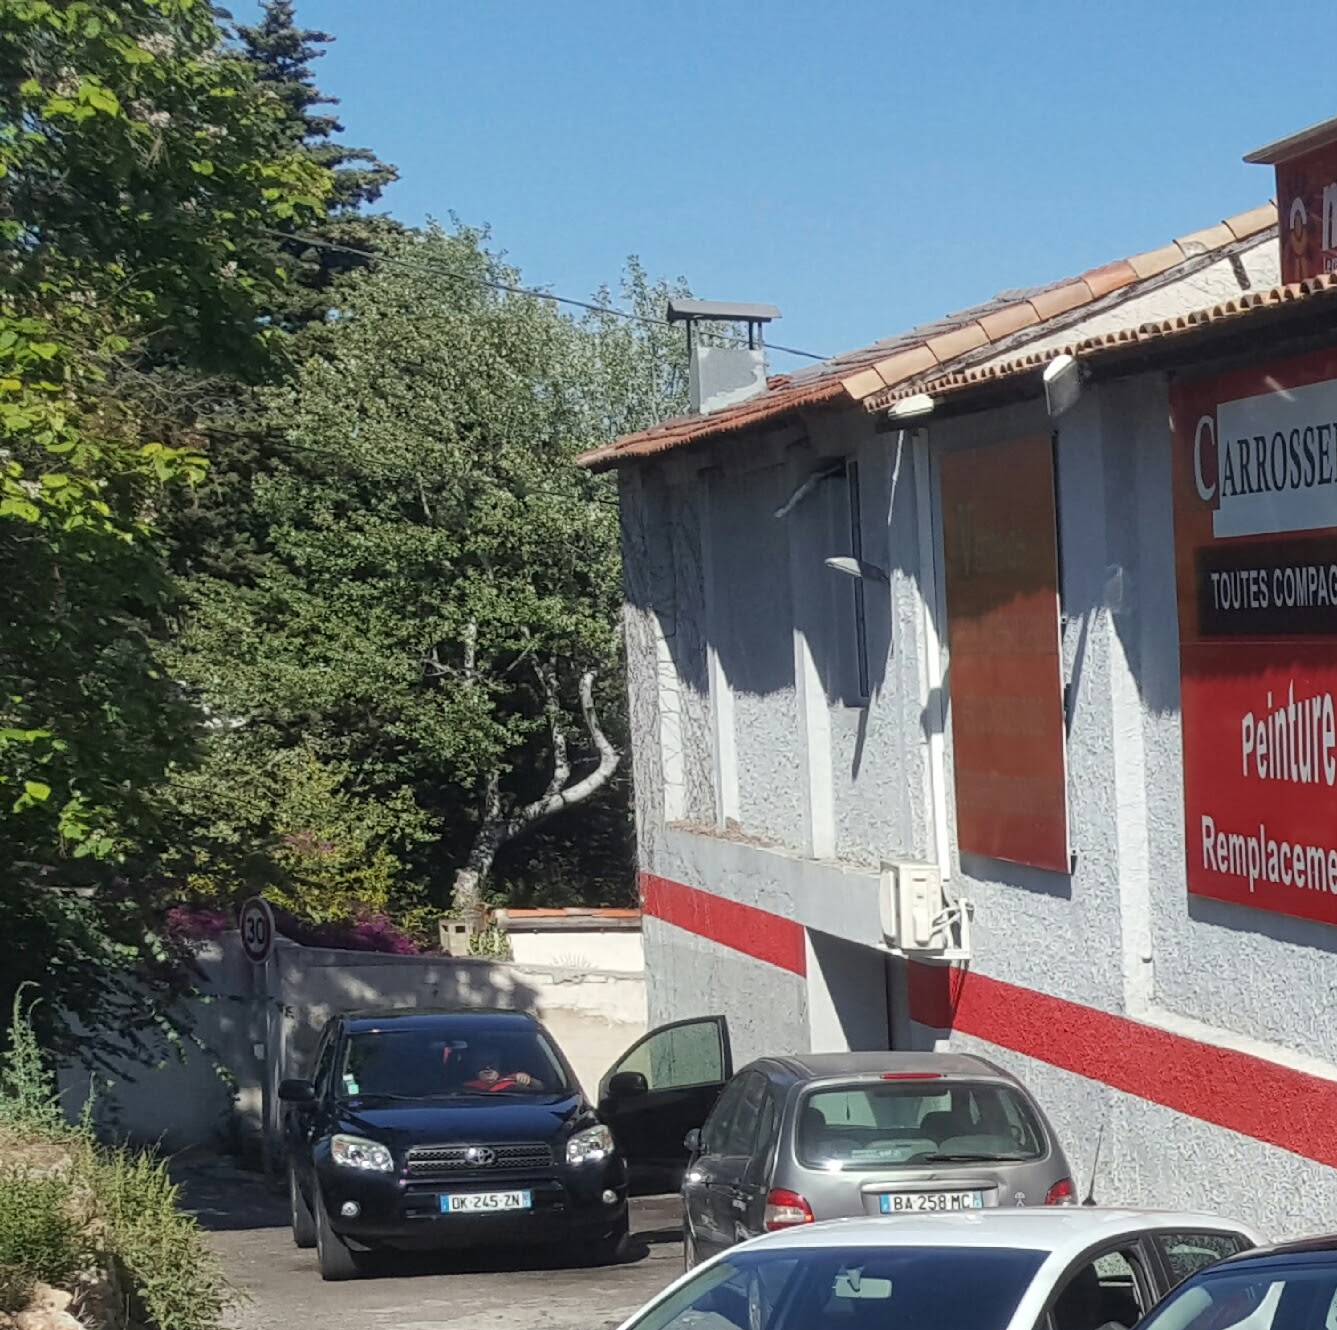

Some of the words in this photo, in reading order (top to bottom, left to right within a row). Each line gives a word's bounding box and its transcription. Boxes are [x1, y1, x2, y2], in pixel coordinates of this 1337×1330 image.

[1211, 566, 1269, 611] TOUTES
[1241, 677, 1336, 788] Peinture
[247, 917, 264, 944] 30
[452, 1193, 520, 1210] DK-245-ZN
